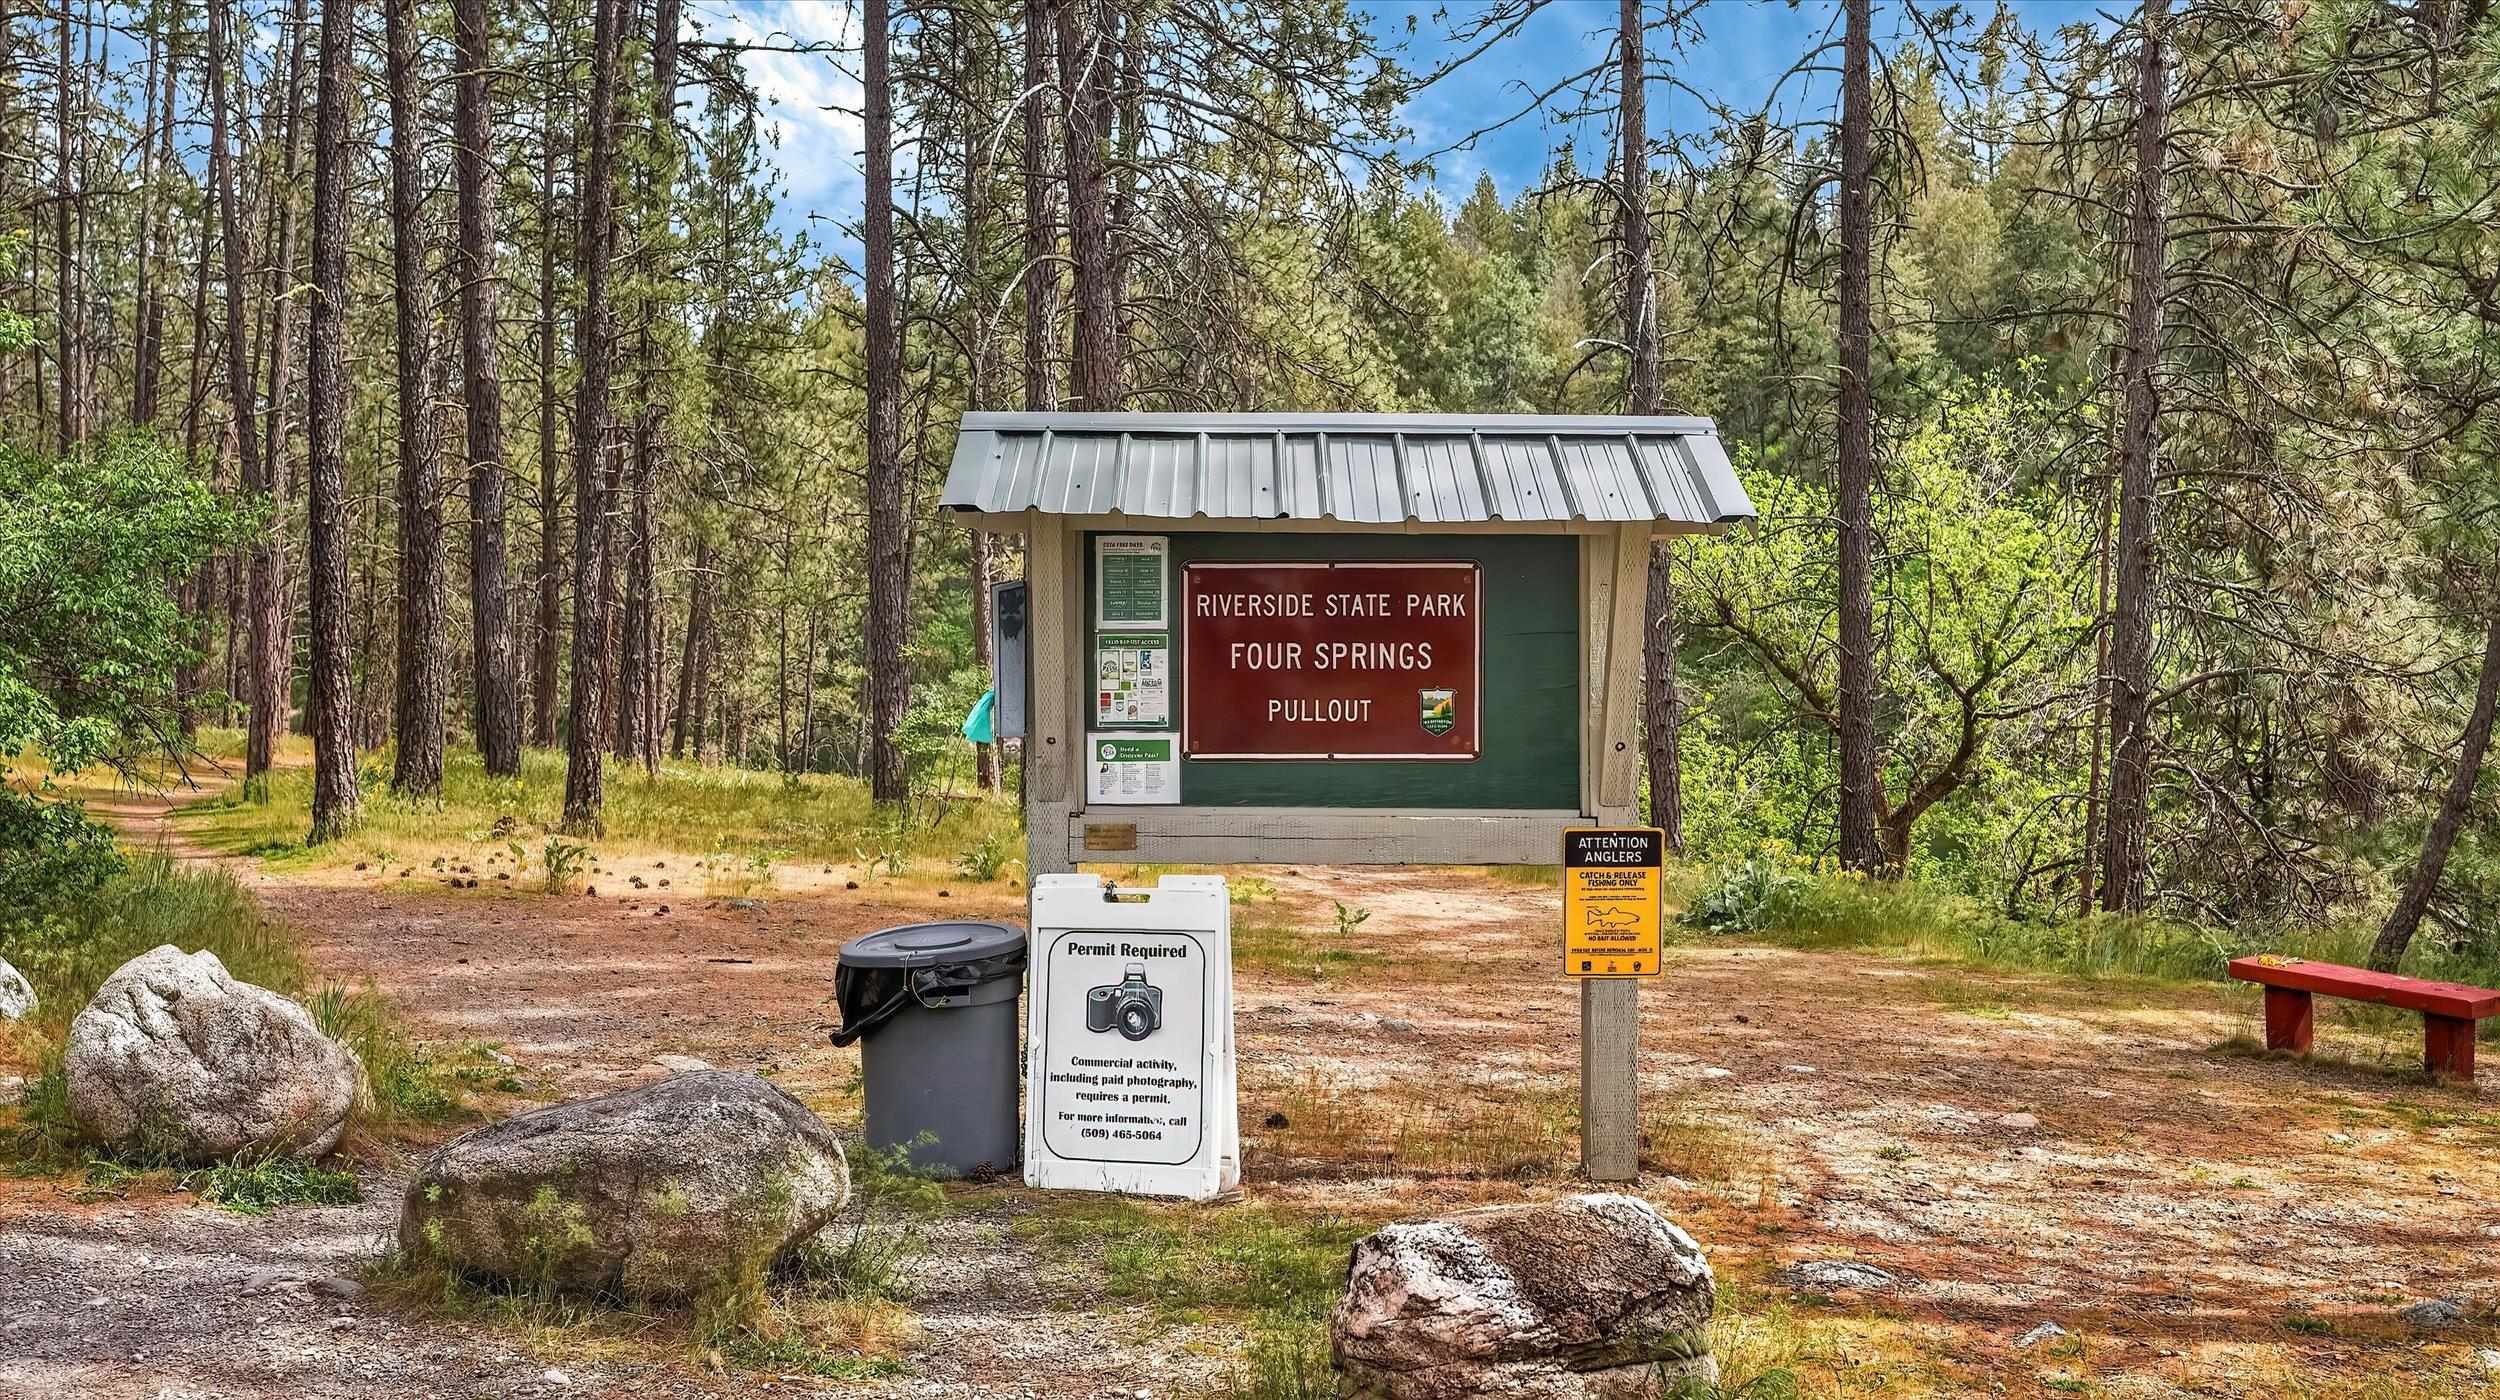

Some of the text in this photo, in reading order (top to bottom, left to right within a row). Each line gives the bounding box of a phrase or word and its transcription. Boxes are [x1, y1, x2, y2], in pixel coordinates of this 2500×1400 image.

[1197, 593, 1466, 617] RIVERSIDE STATE PARK
[1231, 642, 1432, 670] FOUR SPRINGS
[1268, 699, 1372, 722] PULLOUT
[1578, 836, 1648, 849] ATTENTION
[1584, 851, 1642, 863] ANGLERS
[1579, 871, 1647, 880] CATCH & RELEASE
[1588, 879, 1638, 887] FISHING ONLY
[1067, 942, 1187, 960] Permit Required
[1071, 1056, 1177, 1071] Commercial activity,
[1050, 1072, 1198, 1090] including paid photography,
[1075, 1091, 1171, 1104] requires a permit.
[1058, 1111, 1075, 1121] For
[1077, 1113, 1103, 1123] more
[1168, 1116, 1187, 1126] call
[1081, 1128, 1162, 1140] (509) 465-5064
